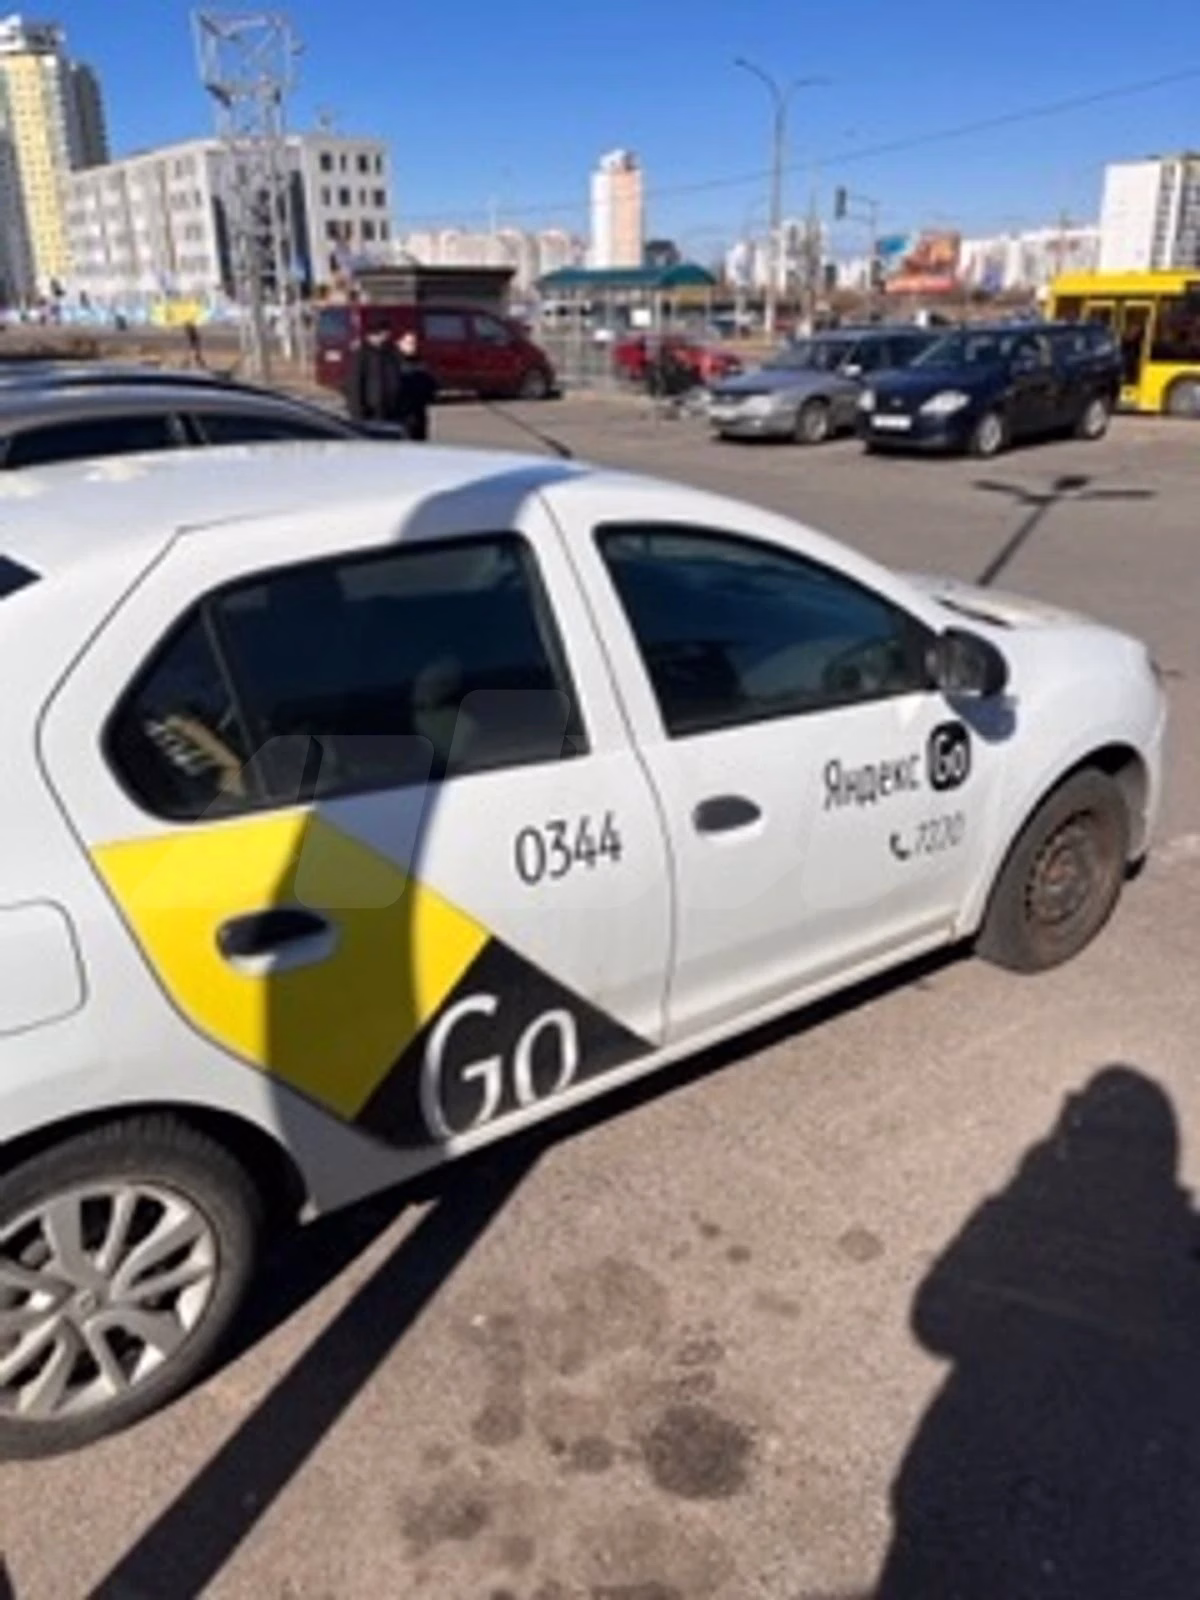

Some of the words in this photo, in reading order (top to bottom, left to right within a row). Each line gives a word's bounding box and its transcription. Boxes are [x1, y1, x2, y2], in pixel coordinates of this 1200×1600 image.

[823, 755, 920, 811] Яндекс
[933, 729, 968, 786] Go
[514, 809, 622, 885] 0344
[419, 993, 578, 1139] Go
